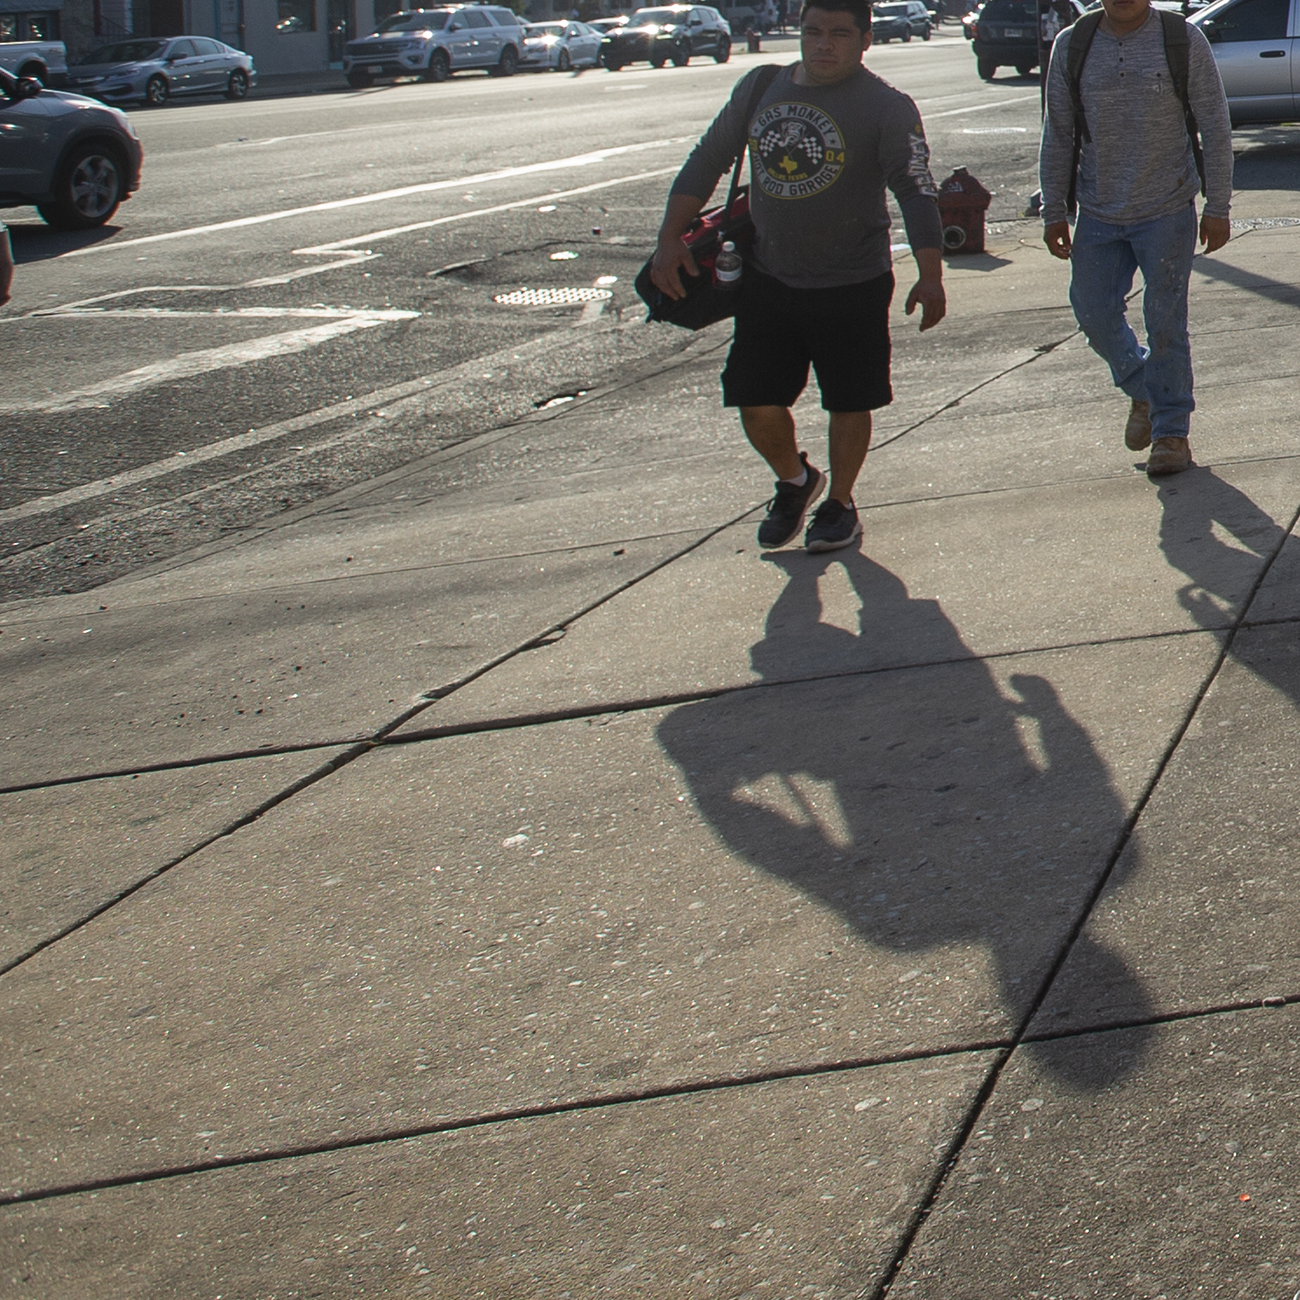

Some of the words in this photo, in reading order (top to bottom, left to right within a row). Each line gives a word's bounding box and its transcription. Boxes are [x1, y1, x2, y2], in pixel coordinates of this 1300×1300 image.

[758, 106, 782, 127] GAS
[787, 105, 837, 137] MONKEY
[763, 176, 784, 196] ROD
[789, 165, 839, 196] GARAGE
